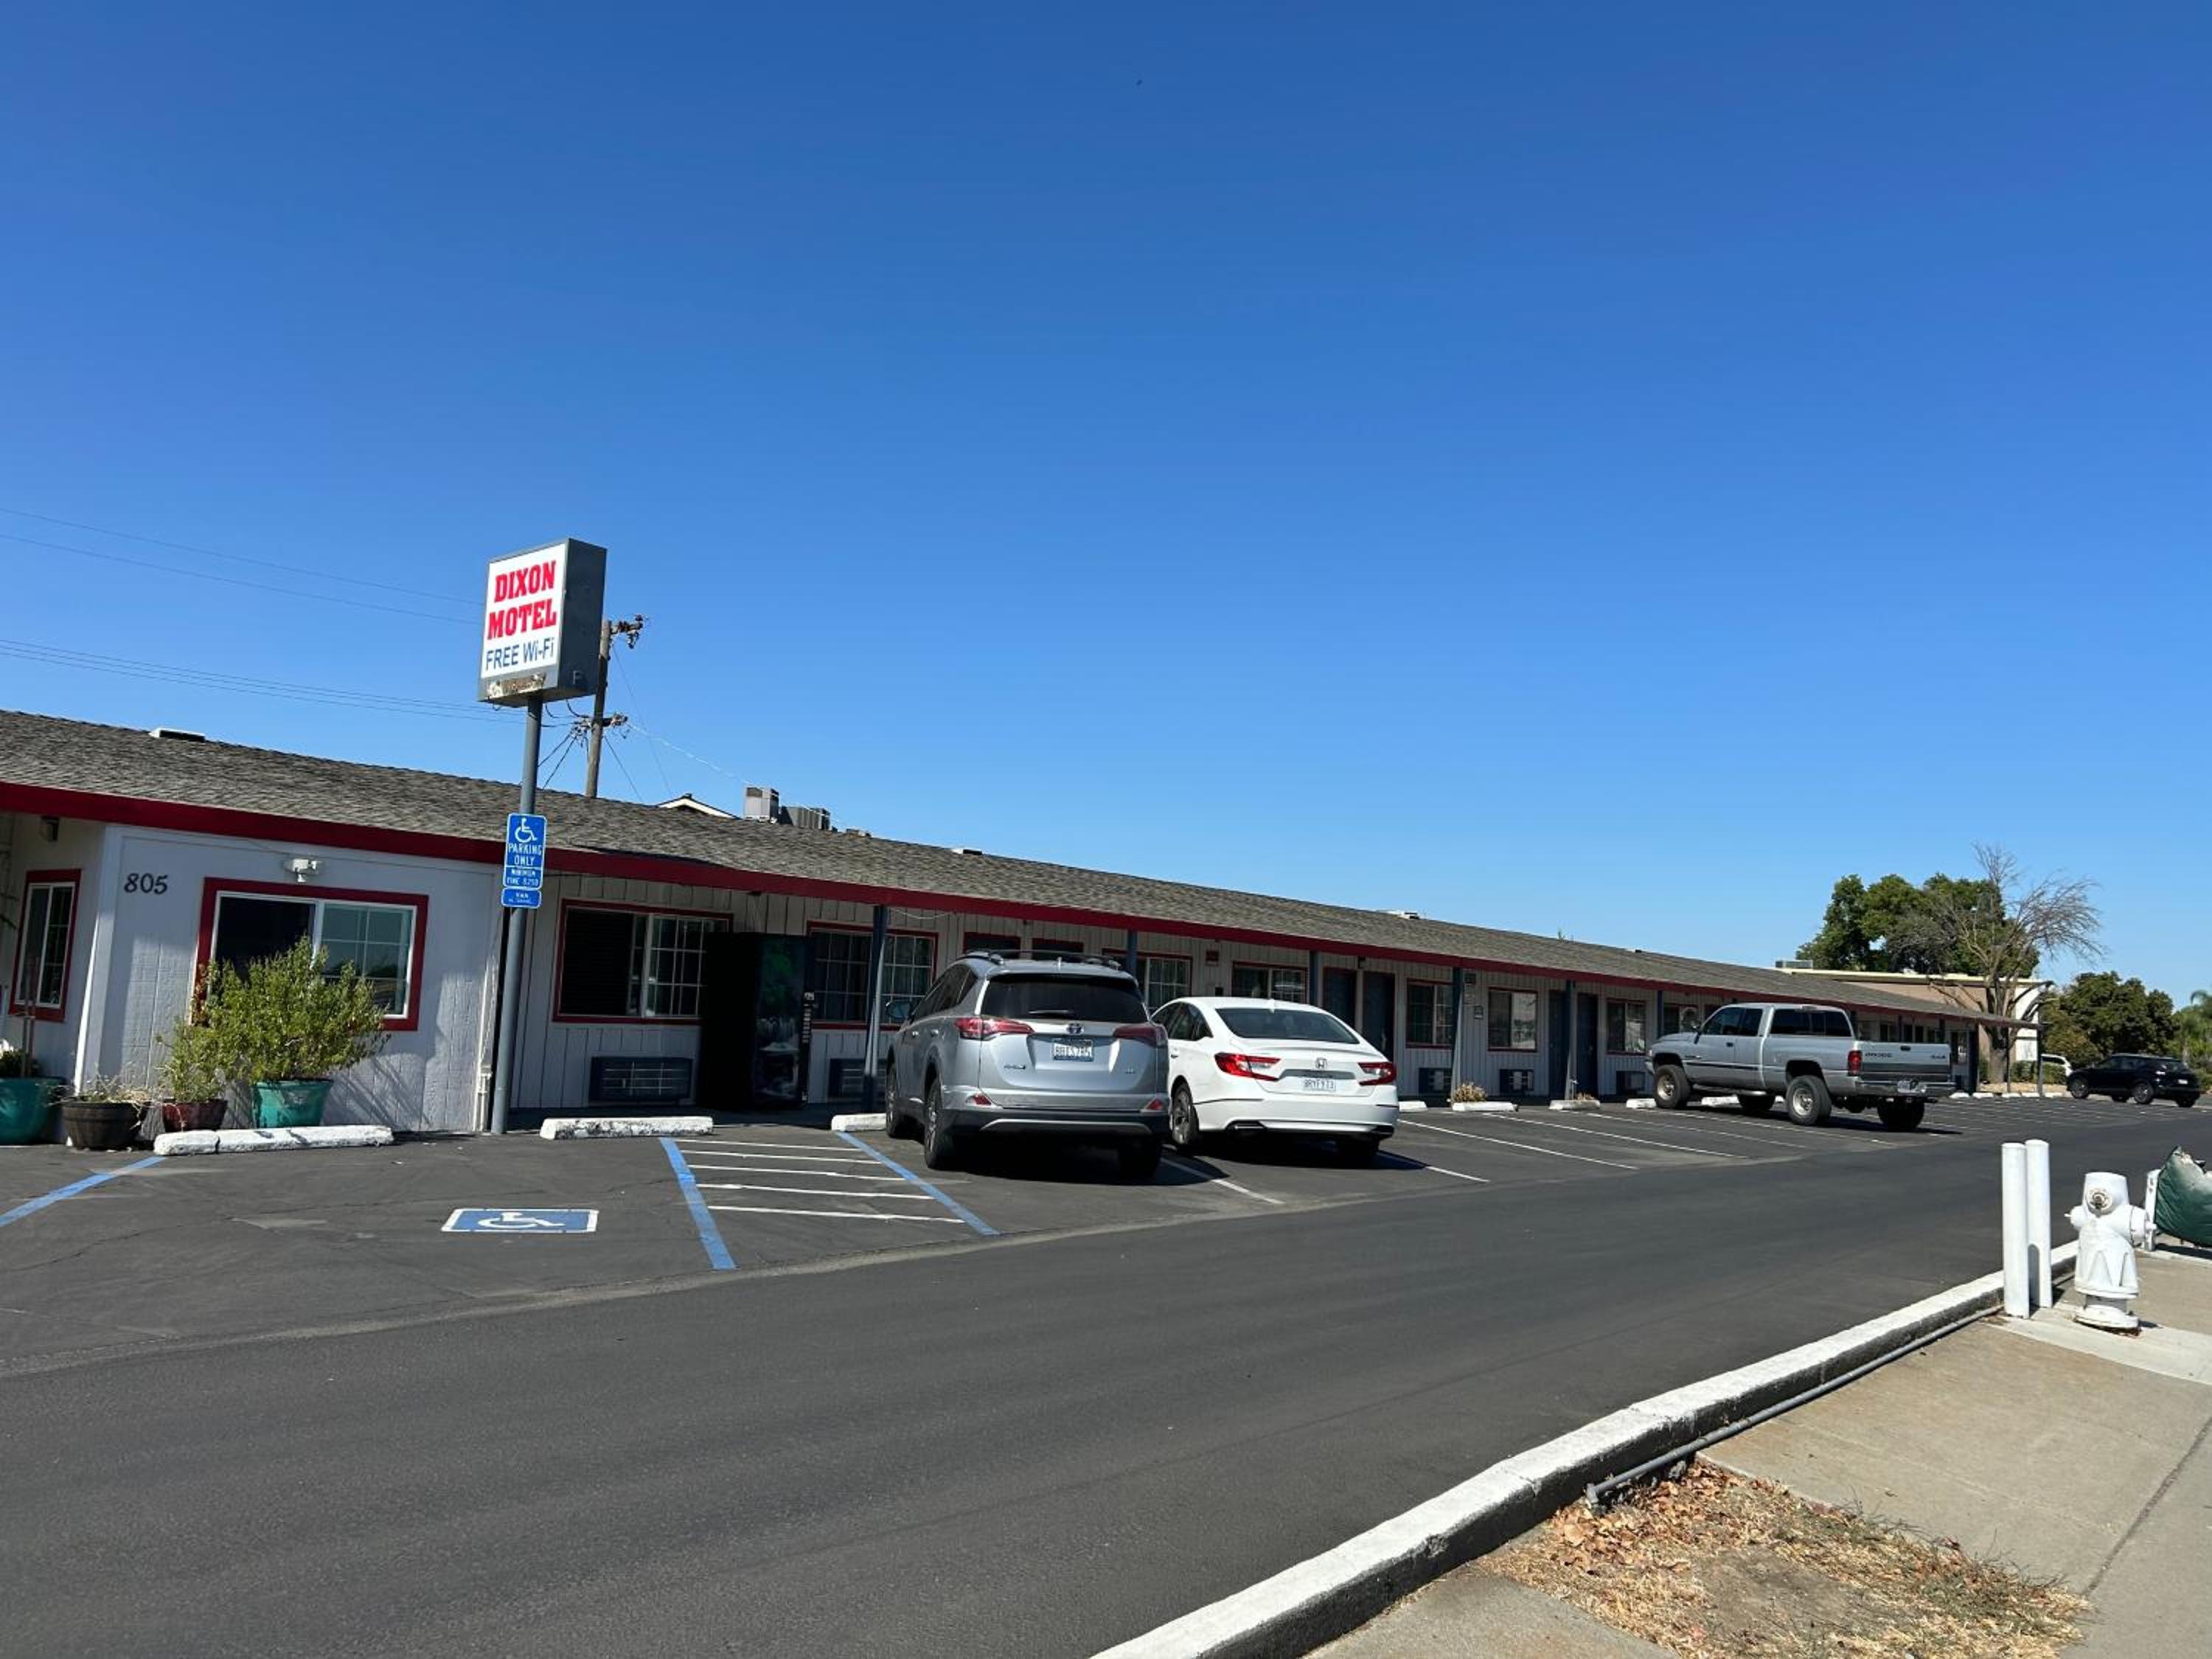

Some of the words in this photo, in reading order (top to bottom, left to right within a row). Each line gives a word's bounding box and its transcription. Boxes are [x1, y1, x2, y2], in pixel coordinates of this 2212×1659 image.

[494, 560, 557, 602] DIXON
[487, 599, 557, 640] MOTEL
[485, 644, 520, 670] FREE
[508, 843, 542, 855] PARKING
[514, 855, 536, 866] ONLY
[124, 873, 168, 894] 805
